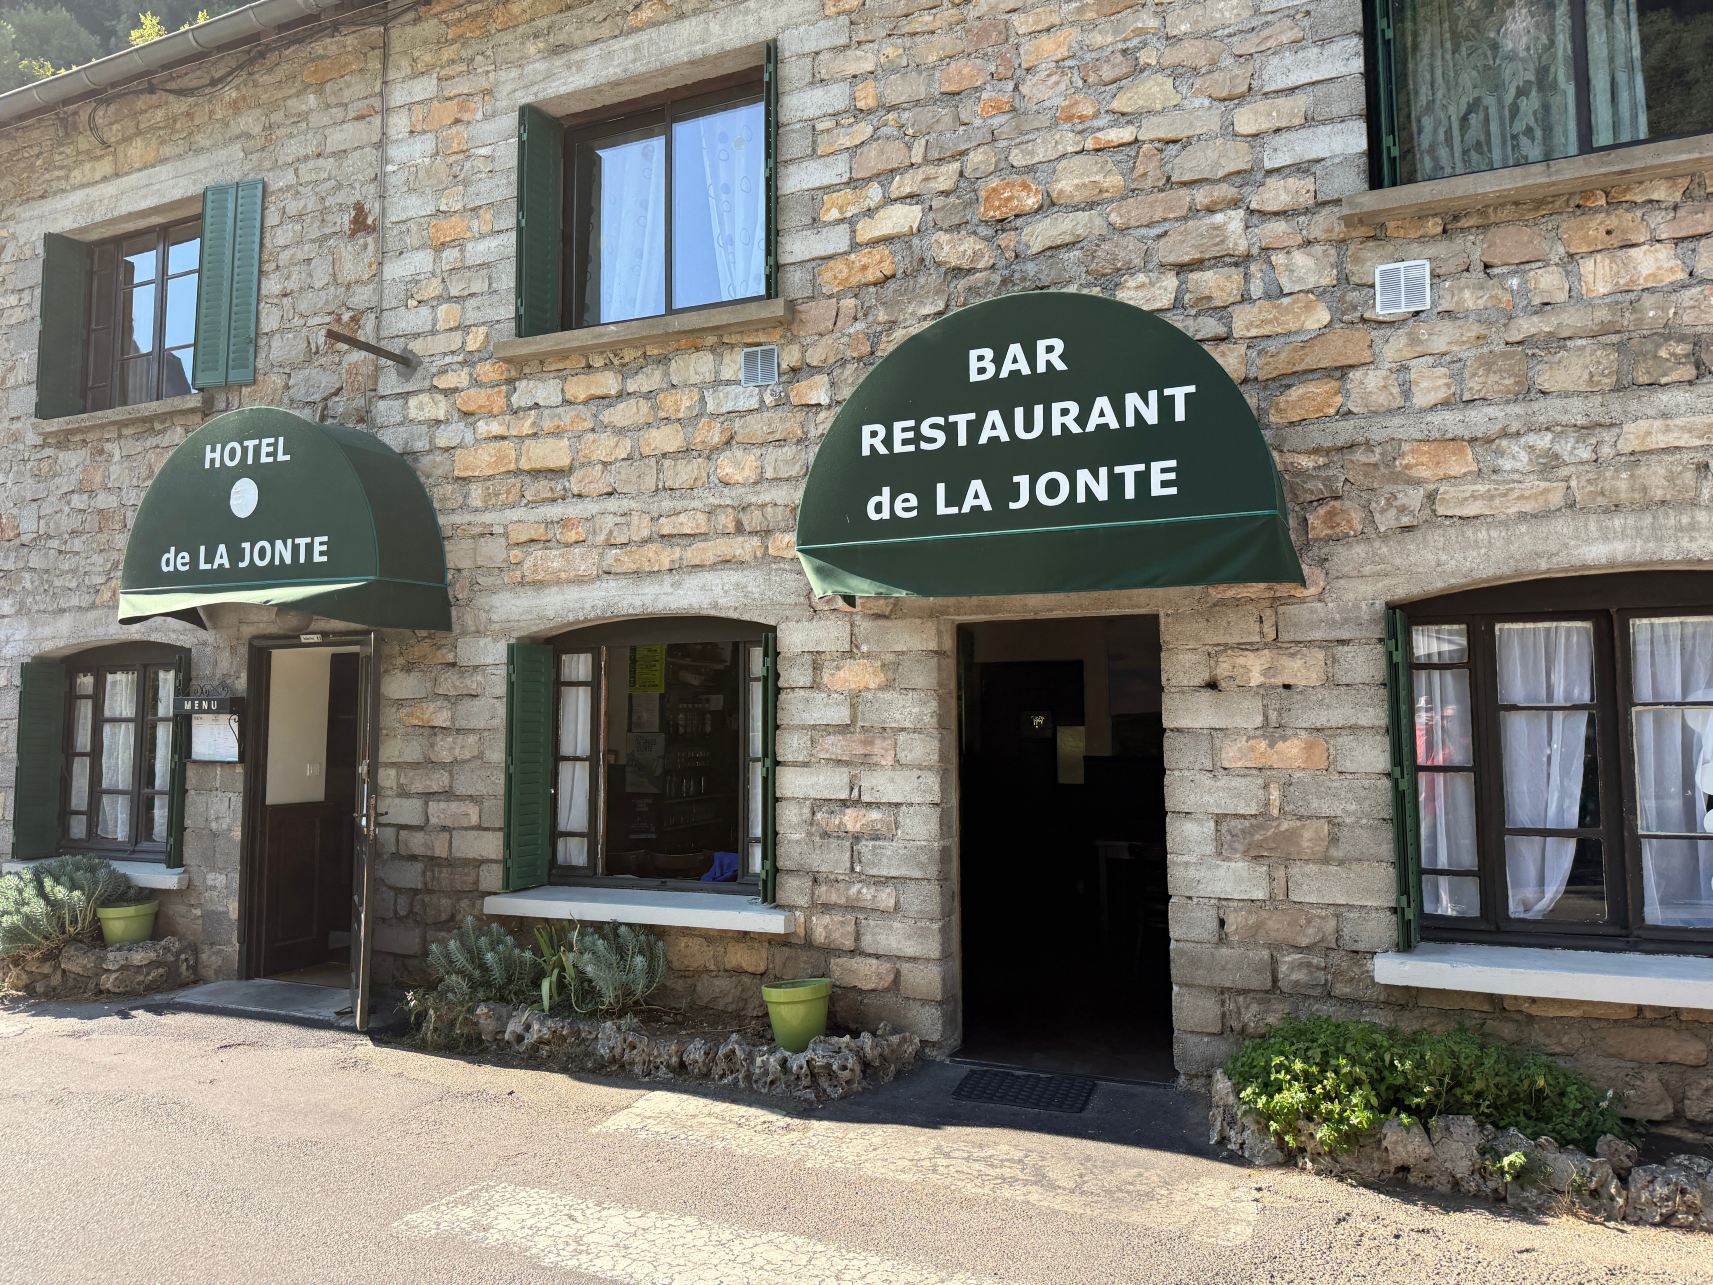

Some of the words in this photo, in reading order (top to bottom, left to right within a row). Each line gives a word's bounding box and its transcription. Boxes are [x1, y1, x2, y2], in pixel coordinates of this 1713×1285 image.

[968, 338, 1068, 383] BAR
[861, 385, 1196, 456] RESTAURANT
[203, 436, 291, 470] HOTEL
[866, 486, 918, 521] de
[936, 478, 993, 516] LA
[1008, 459, 1178, 510] JONTE
[160, 546, 190, 573] de
[198, 543, 231, 570] LA
[238, 535, 329, 568] JONTE
[184, 700, 218, 710] MENU
